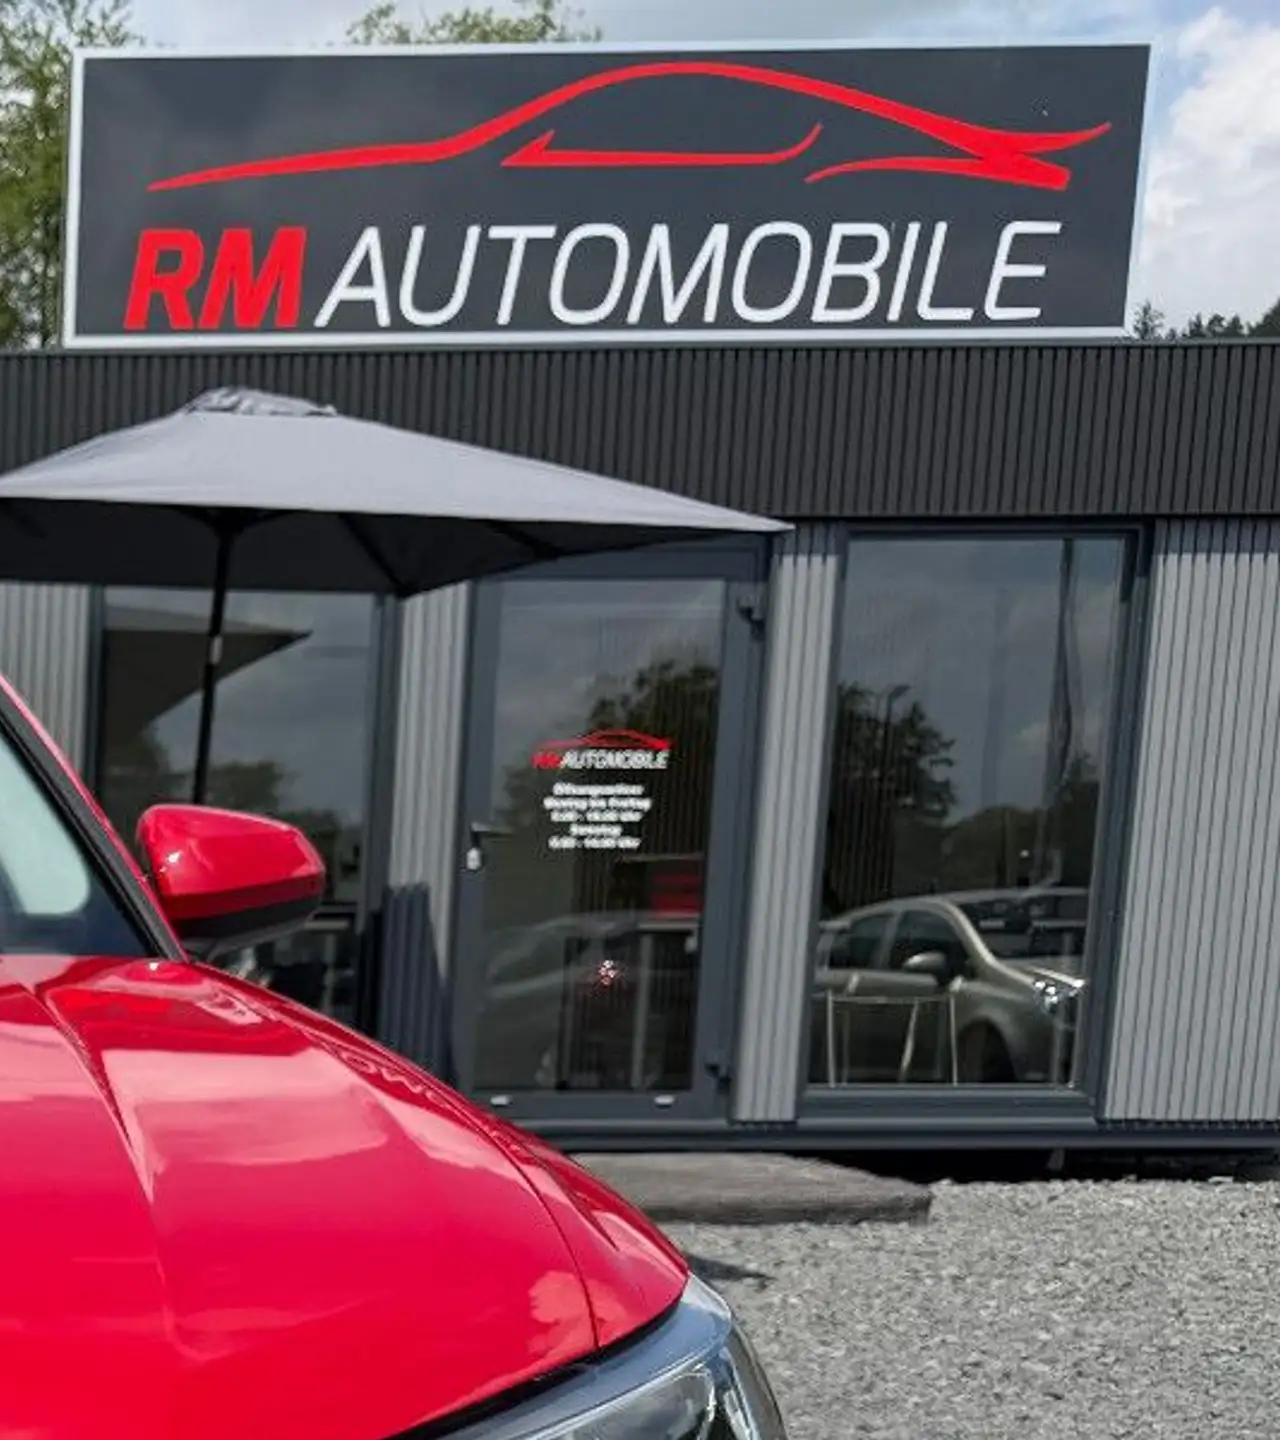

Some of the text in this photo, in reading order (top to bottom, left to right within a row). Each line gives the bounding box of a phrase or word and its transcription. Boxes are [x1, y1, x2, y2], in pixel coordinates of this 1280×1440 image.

[123, 219, 1062, 330] RM AUTOMOBILE
[559, 749, 670, 769] AUTOMOBILE
